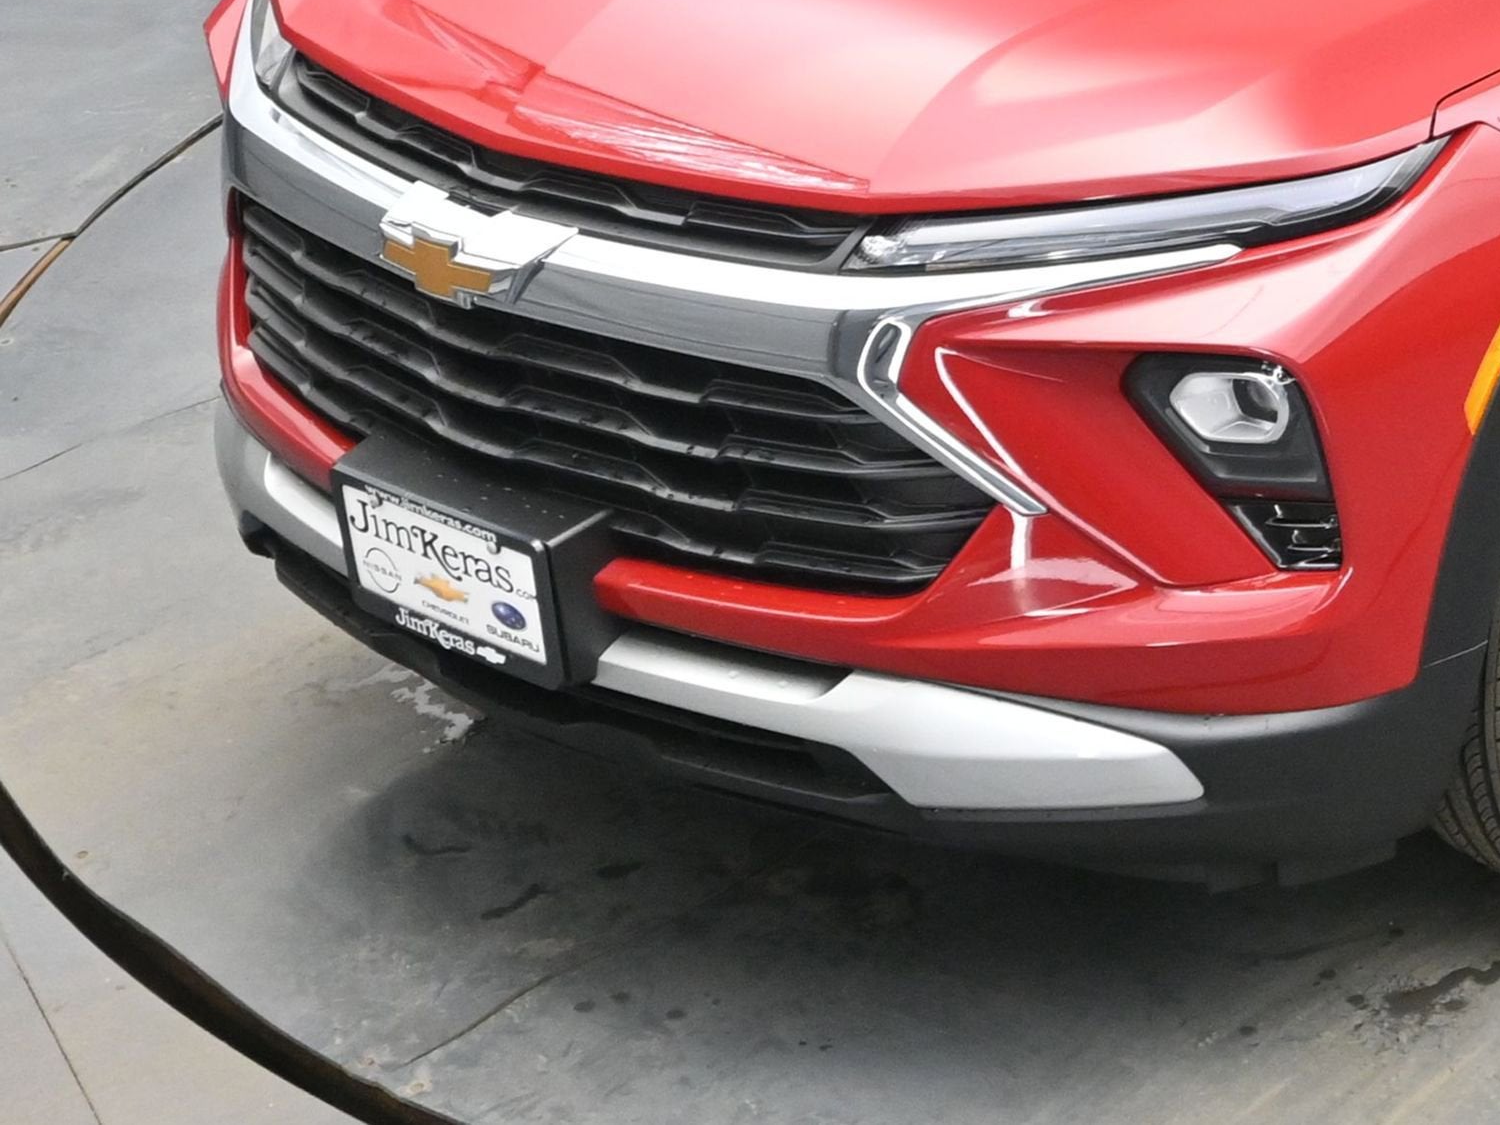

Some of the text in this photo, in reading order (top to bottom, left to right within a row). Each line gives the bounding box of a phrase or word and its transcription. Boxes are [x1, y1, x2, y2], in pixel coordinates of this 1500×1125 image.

[363, 559, 402, 582] NISSAN
[422, 600, 470, 625] CHEVROLET
[486, 624, 540, 653] SUBARU
